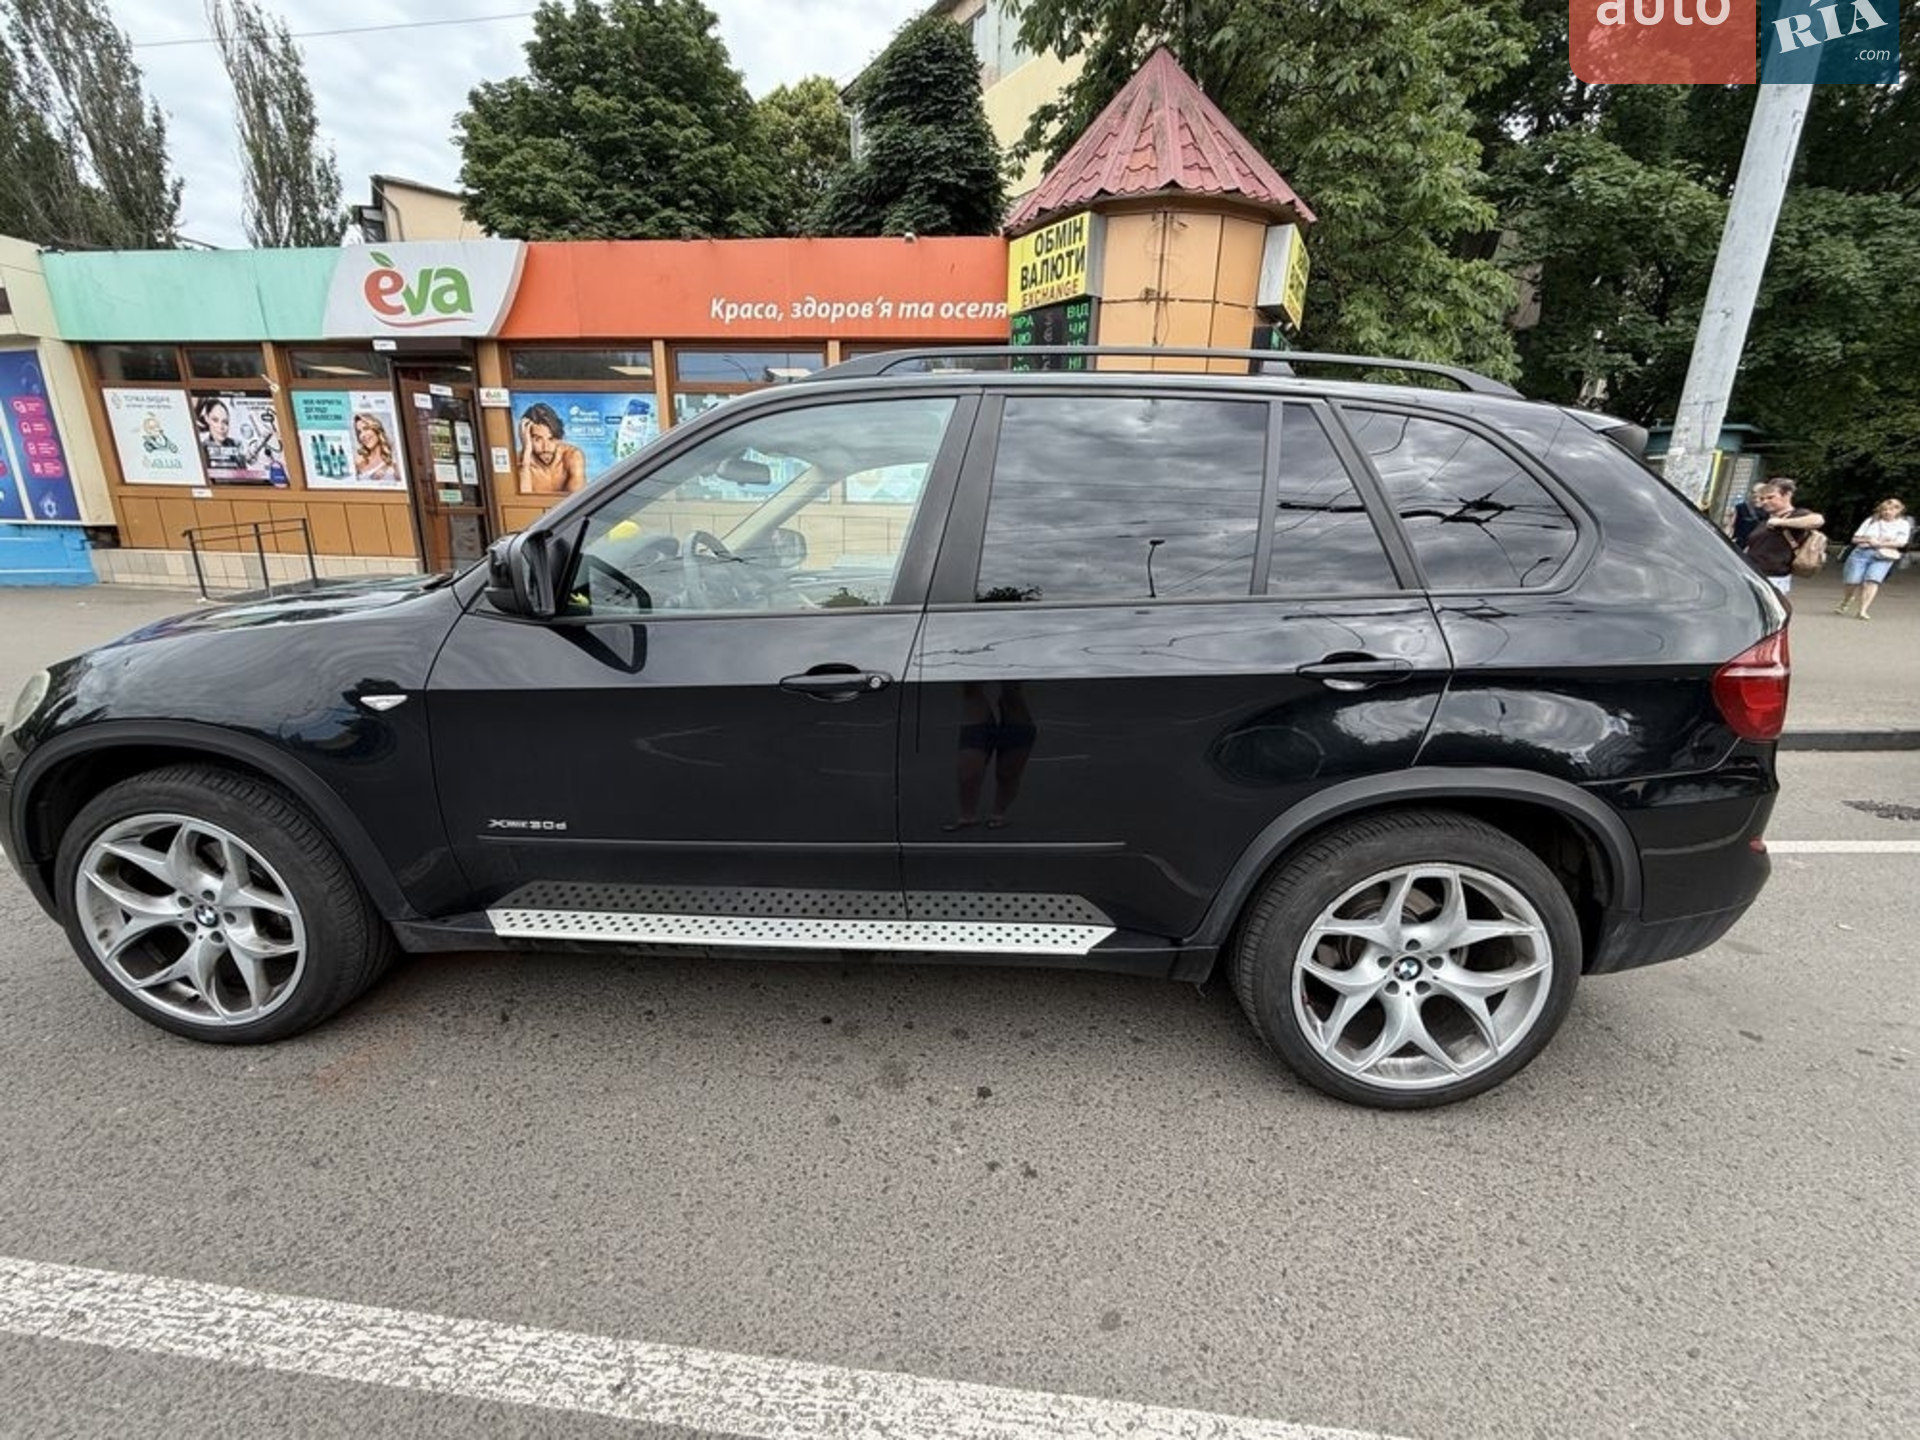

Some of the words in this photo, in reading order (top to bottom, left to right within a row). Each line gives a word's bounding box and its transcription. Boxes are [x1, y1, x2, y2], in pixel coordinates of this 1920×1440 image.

[1034, 216, 1084, 257] ОБМІН
[1020, 245, 1086, 292] ВАЛЮТИ
[710, 297, 784, 323] Краса,
[898, 300, 935, 319] та
[939, 300, 1008, 319] оселя
[1021, 278, 1080, 307] EXCHANGE
